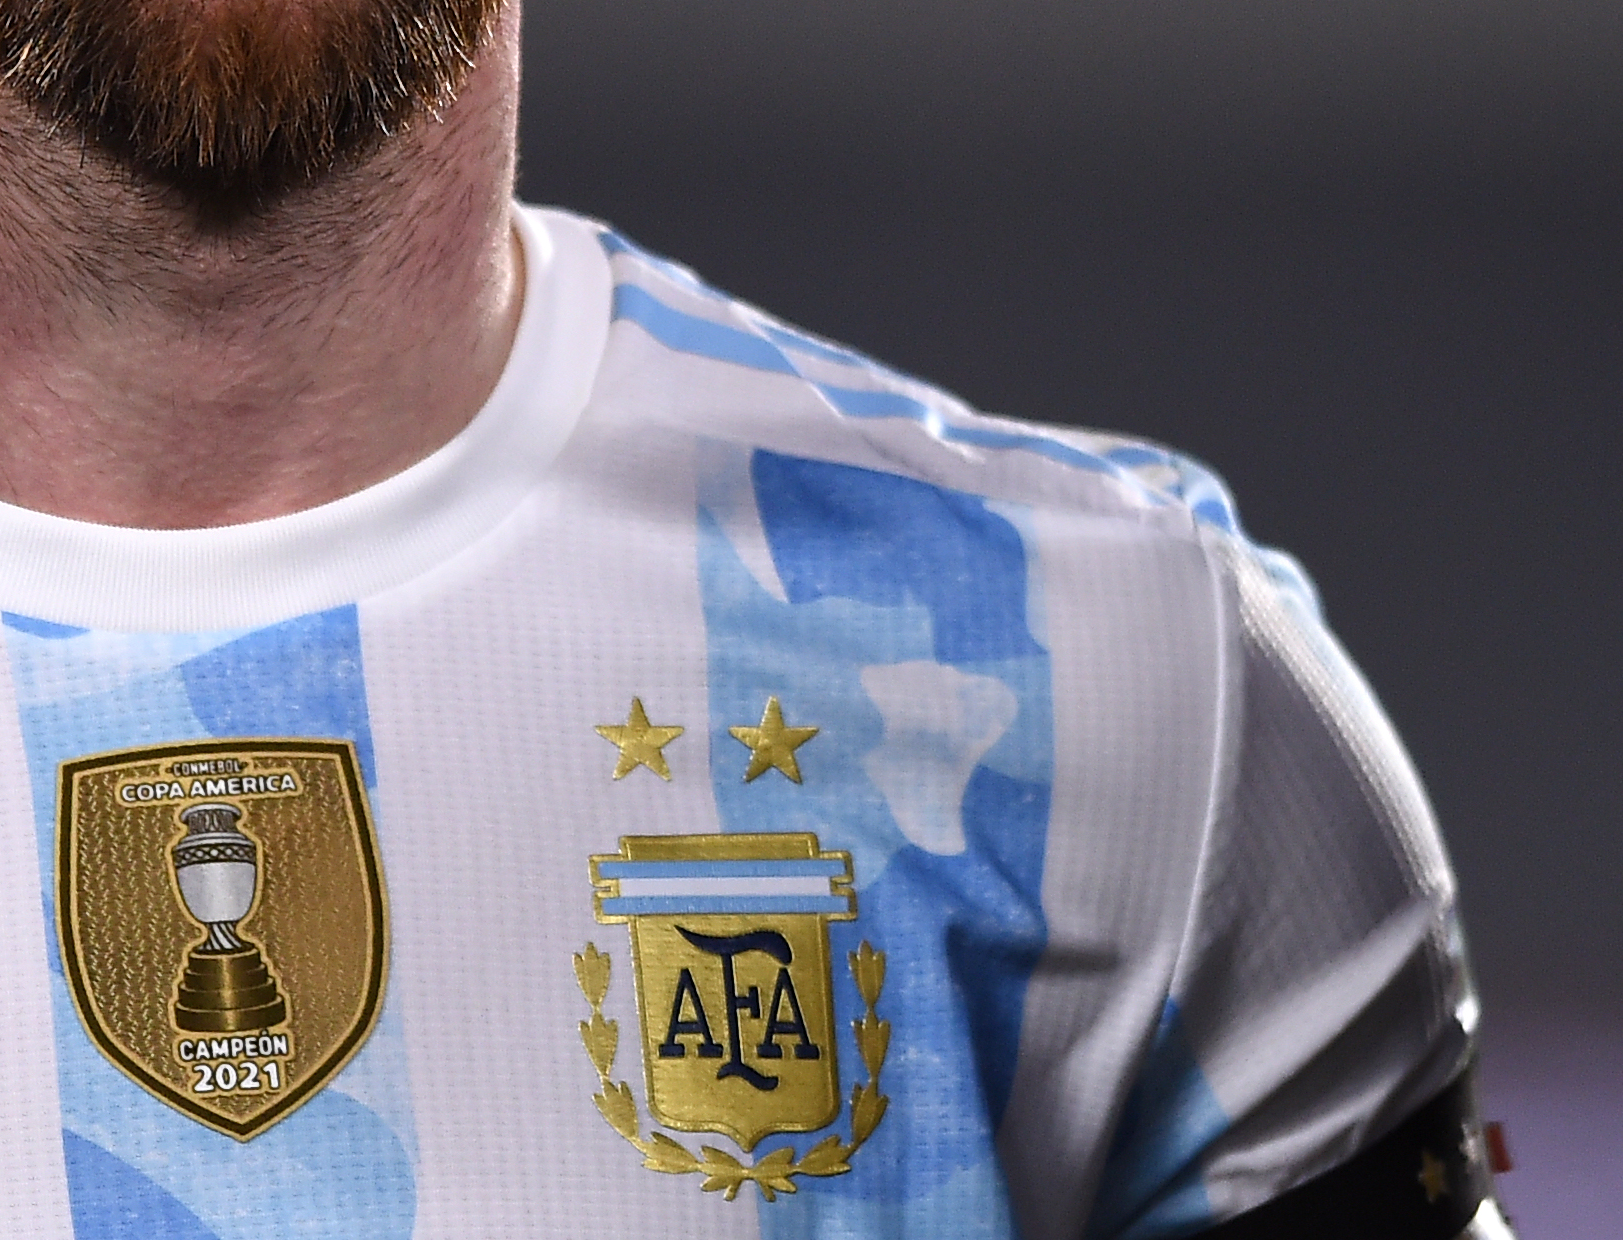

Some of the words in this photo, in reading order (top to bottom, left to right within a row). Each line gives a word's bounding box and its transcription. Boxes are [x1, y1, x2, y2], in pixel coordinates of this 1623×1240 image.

[175, 760, 241, 776] CONMEBOL
[122, 783, 184, 802] COPA
[190, 774, 296, 798] AMERICA
[658, 924, 821, 1091] AFA
[179, 1030, 288, 1060] CAMPEÓN
[193, 1062, 280, 1092] 2021
